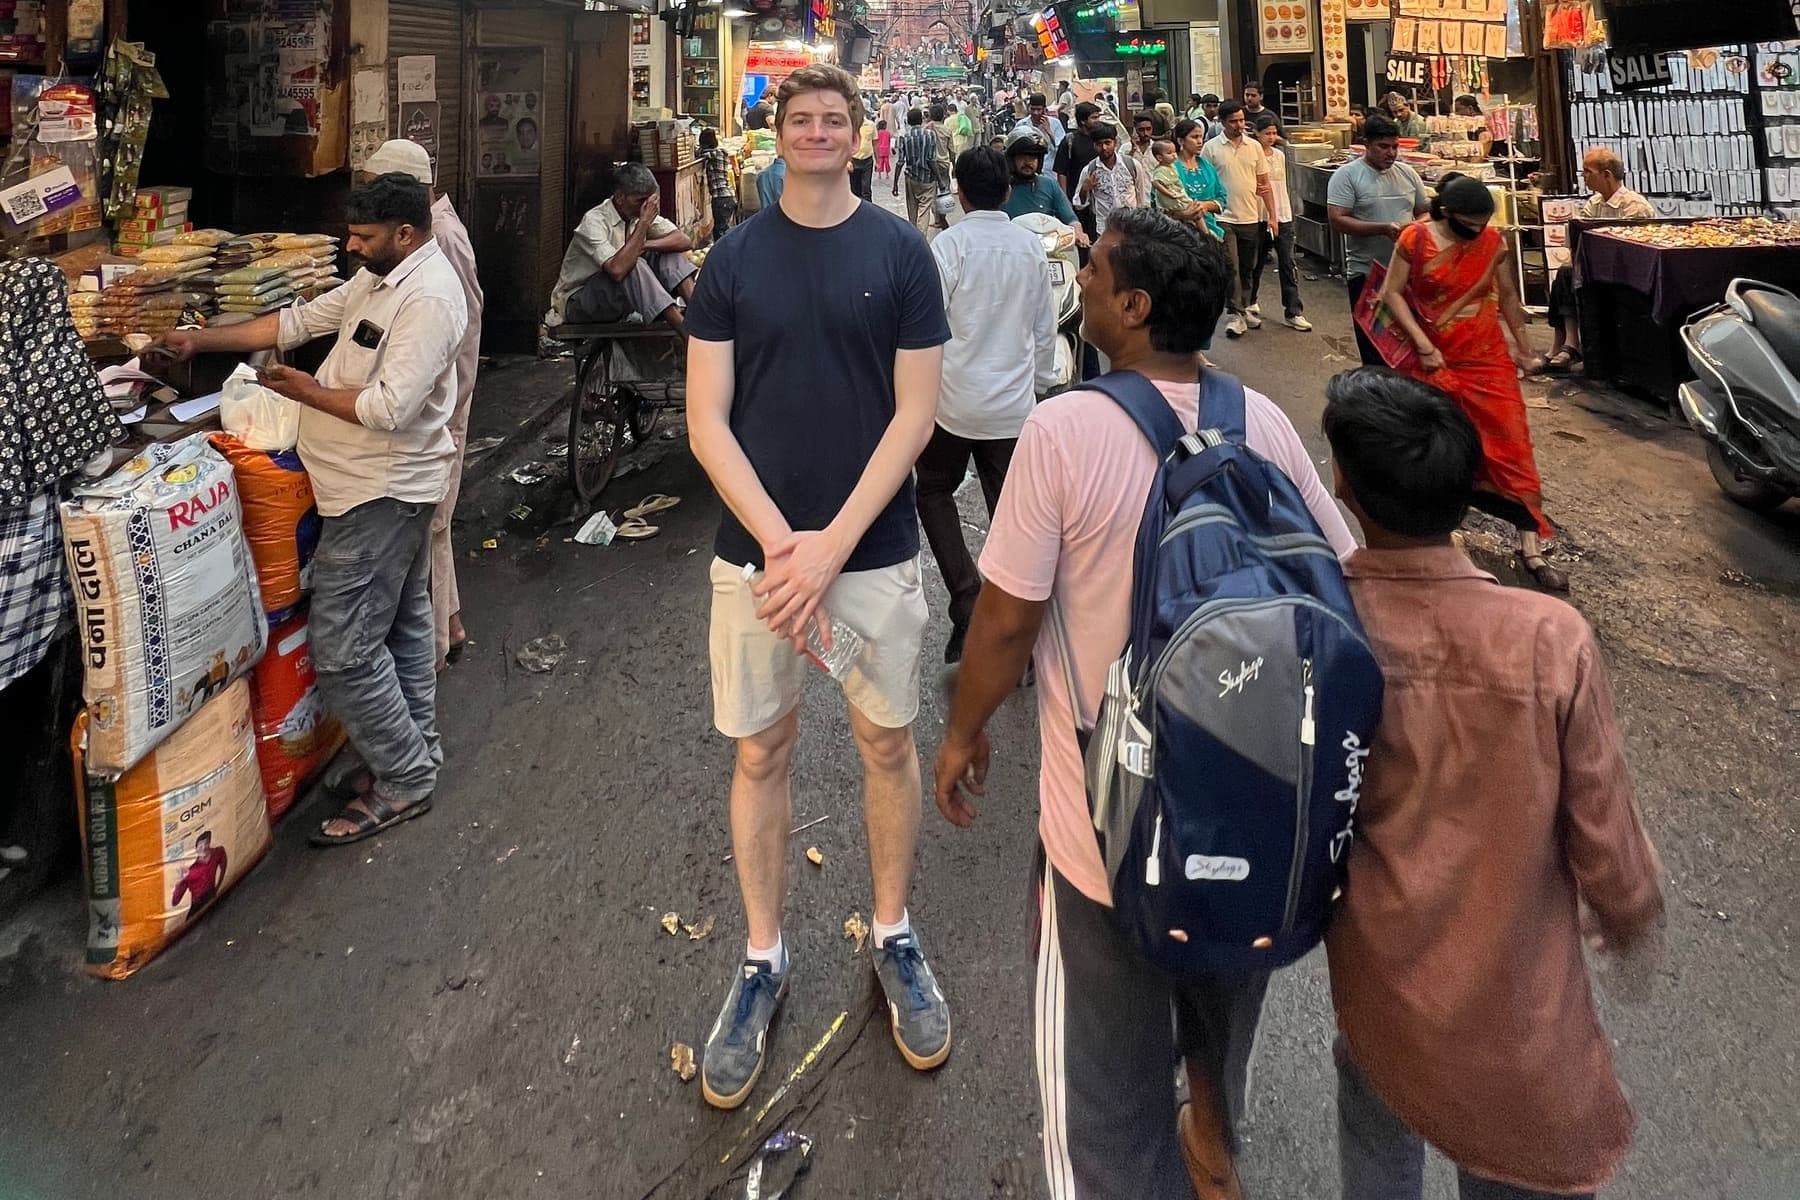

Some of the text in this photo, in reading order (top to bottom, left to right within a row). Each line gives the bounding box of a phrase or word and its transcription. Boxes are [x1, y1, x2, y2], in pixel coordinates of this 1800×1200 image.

[1386, 59, 1424, 85] SALE
[1612, 52, 1671, 86] SALE
[166, 480, 230, 533] RAJA
[173, 525, 216, 555] CHANA
[69, 539, 107, 670] चना दाल
[180, 797, 212, 824] GRM
